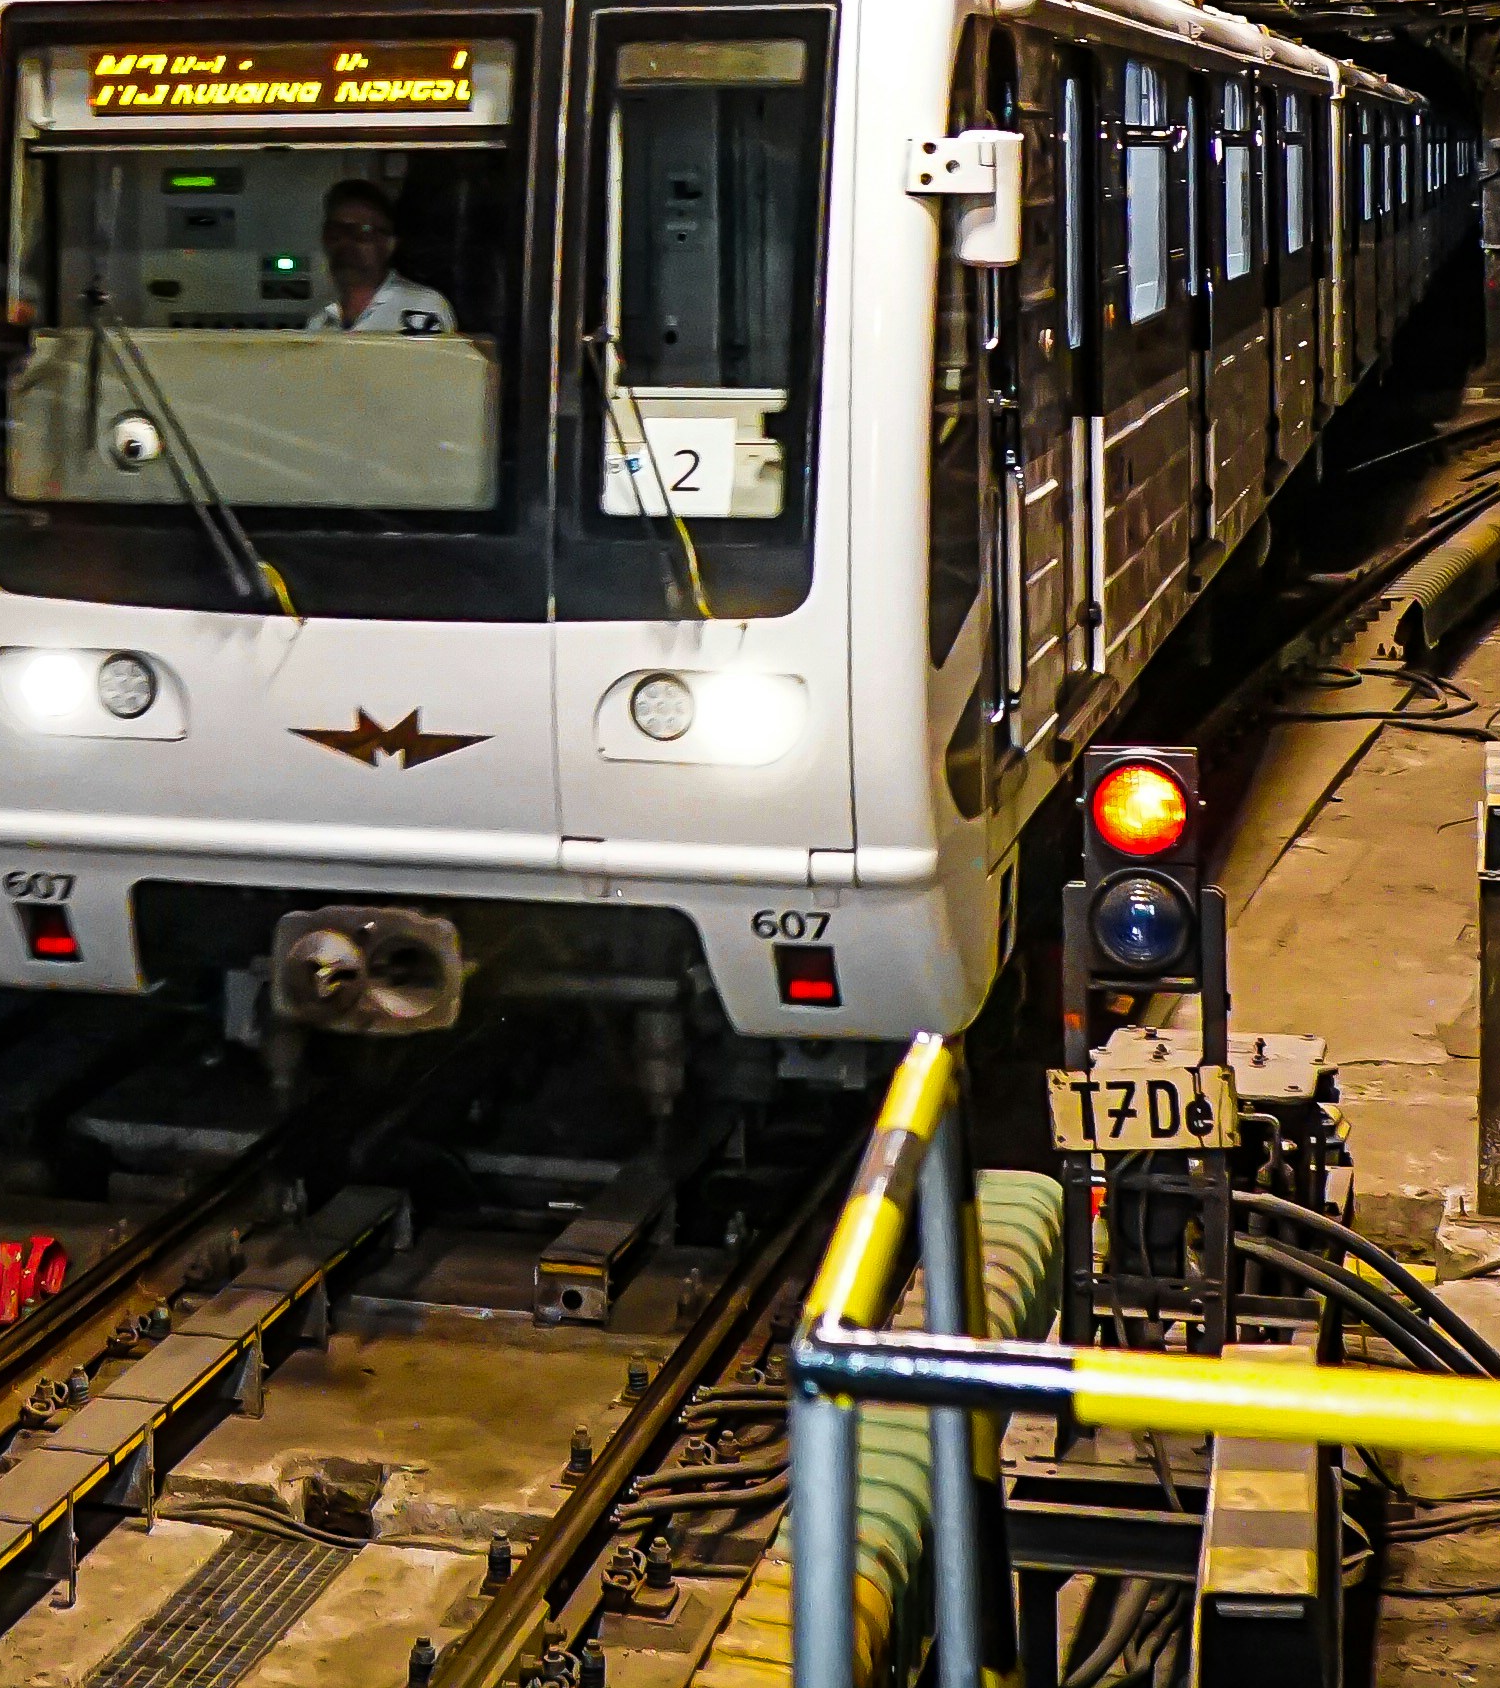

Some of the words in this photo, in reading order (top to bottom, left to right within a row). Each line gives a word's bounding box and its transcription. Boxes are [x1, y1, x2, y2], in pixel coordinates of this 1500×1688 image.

[671, 449, 700, 491] 2
[2, 871, 76, 901] 607
[751, 909, 832, 942] 607
[1069, 1079, 1215, 1139] T7De
